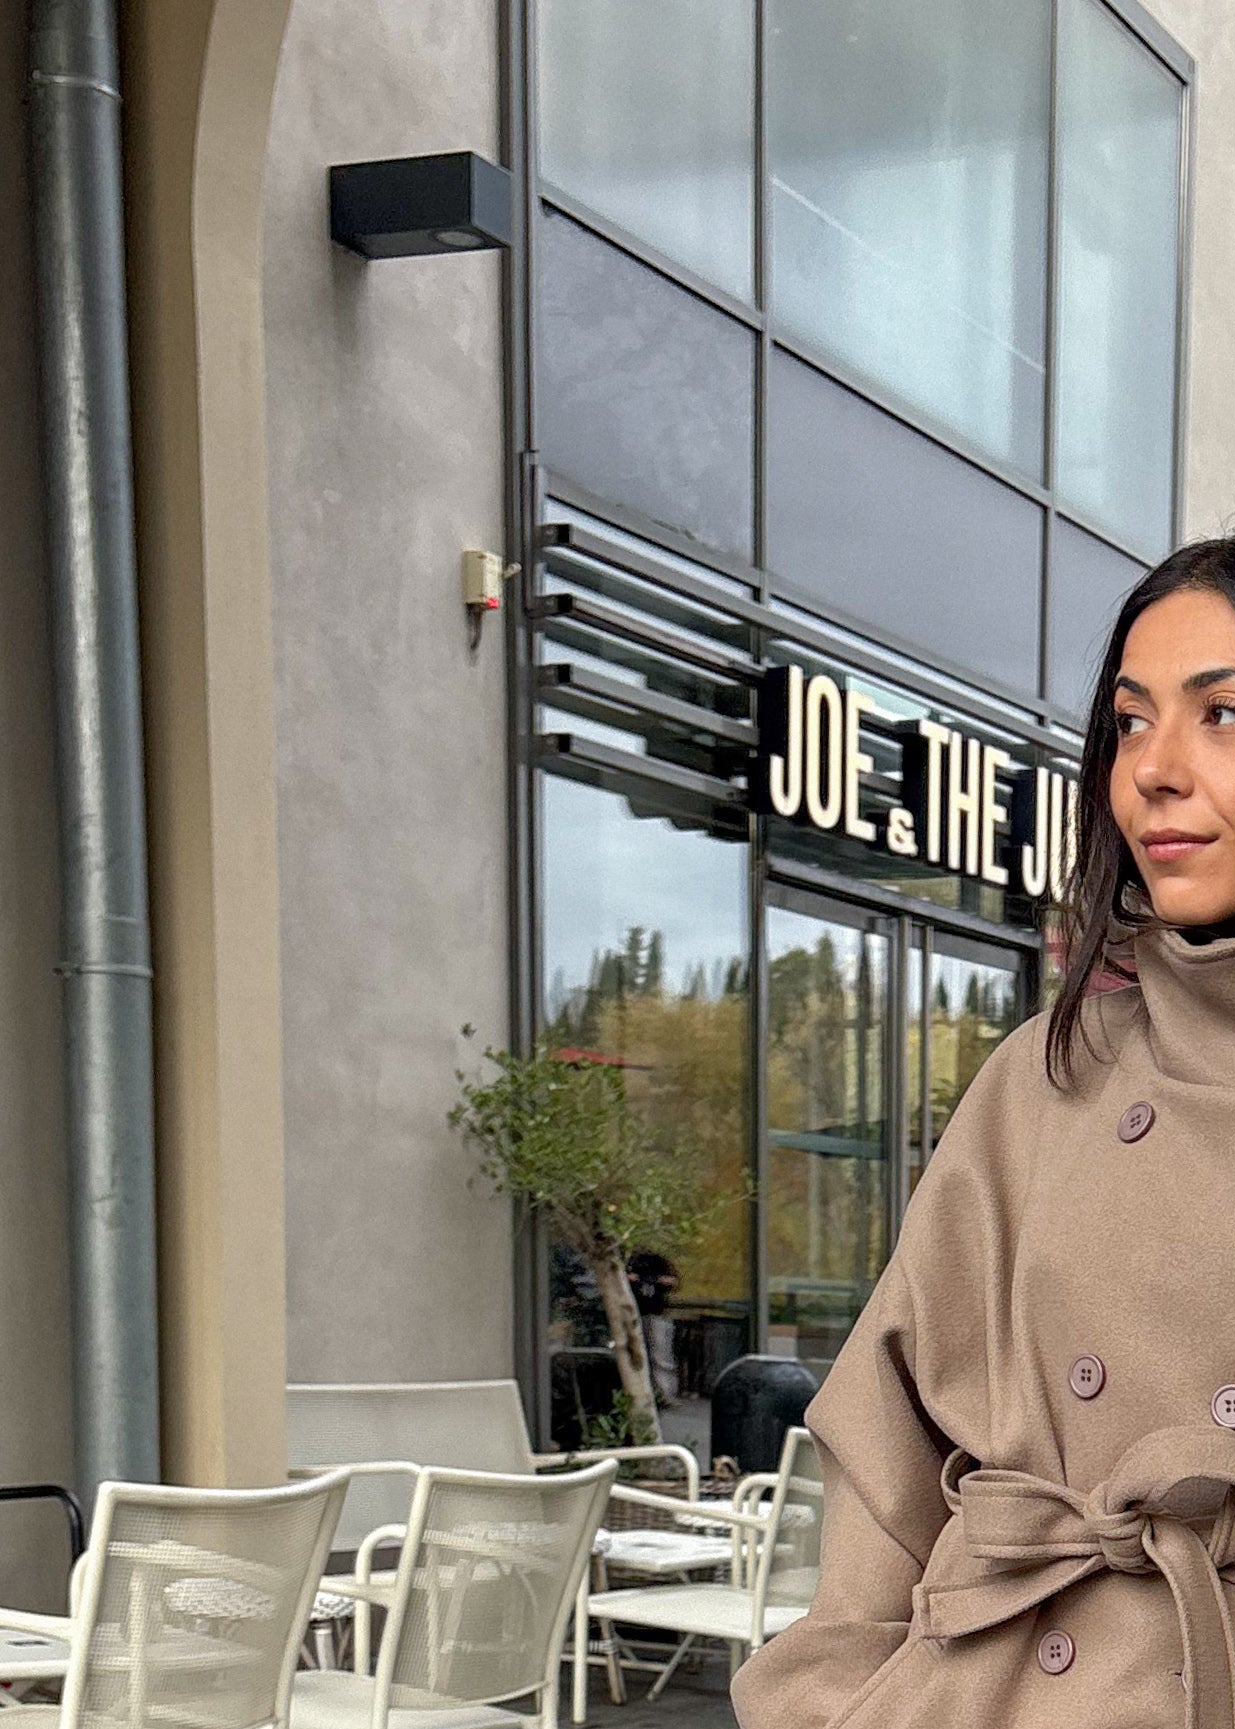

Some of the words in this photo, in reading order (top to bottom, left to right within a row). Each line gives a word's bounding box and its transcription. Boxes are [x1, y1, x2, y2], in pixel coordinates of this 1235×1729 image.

[769, 664, 876, 842] JOE
[886, 807, 918, 856] &
[919, 718, 1009, 886] THE
